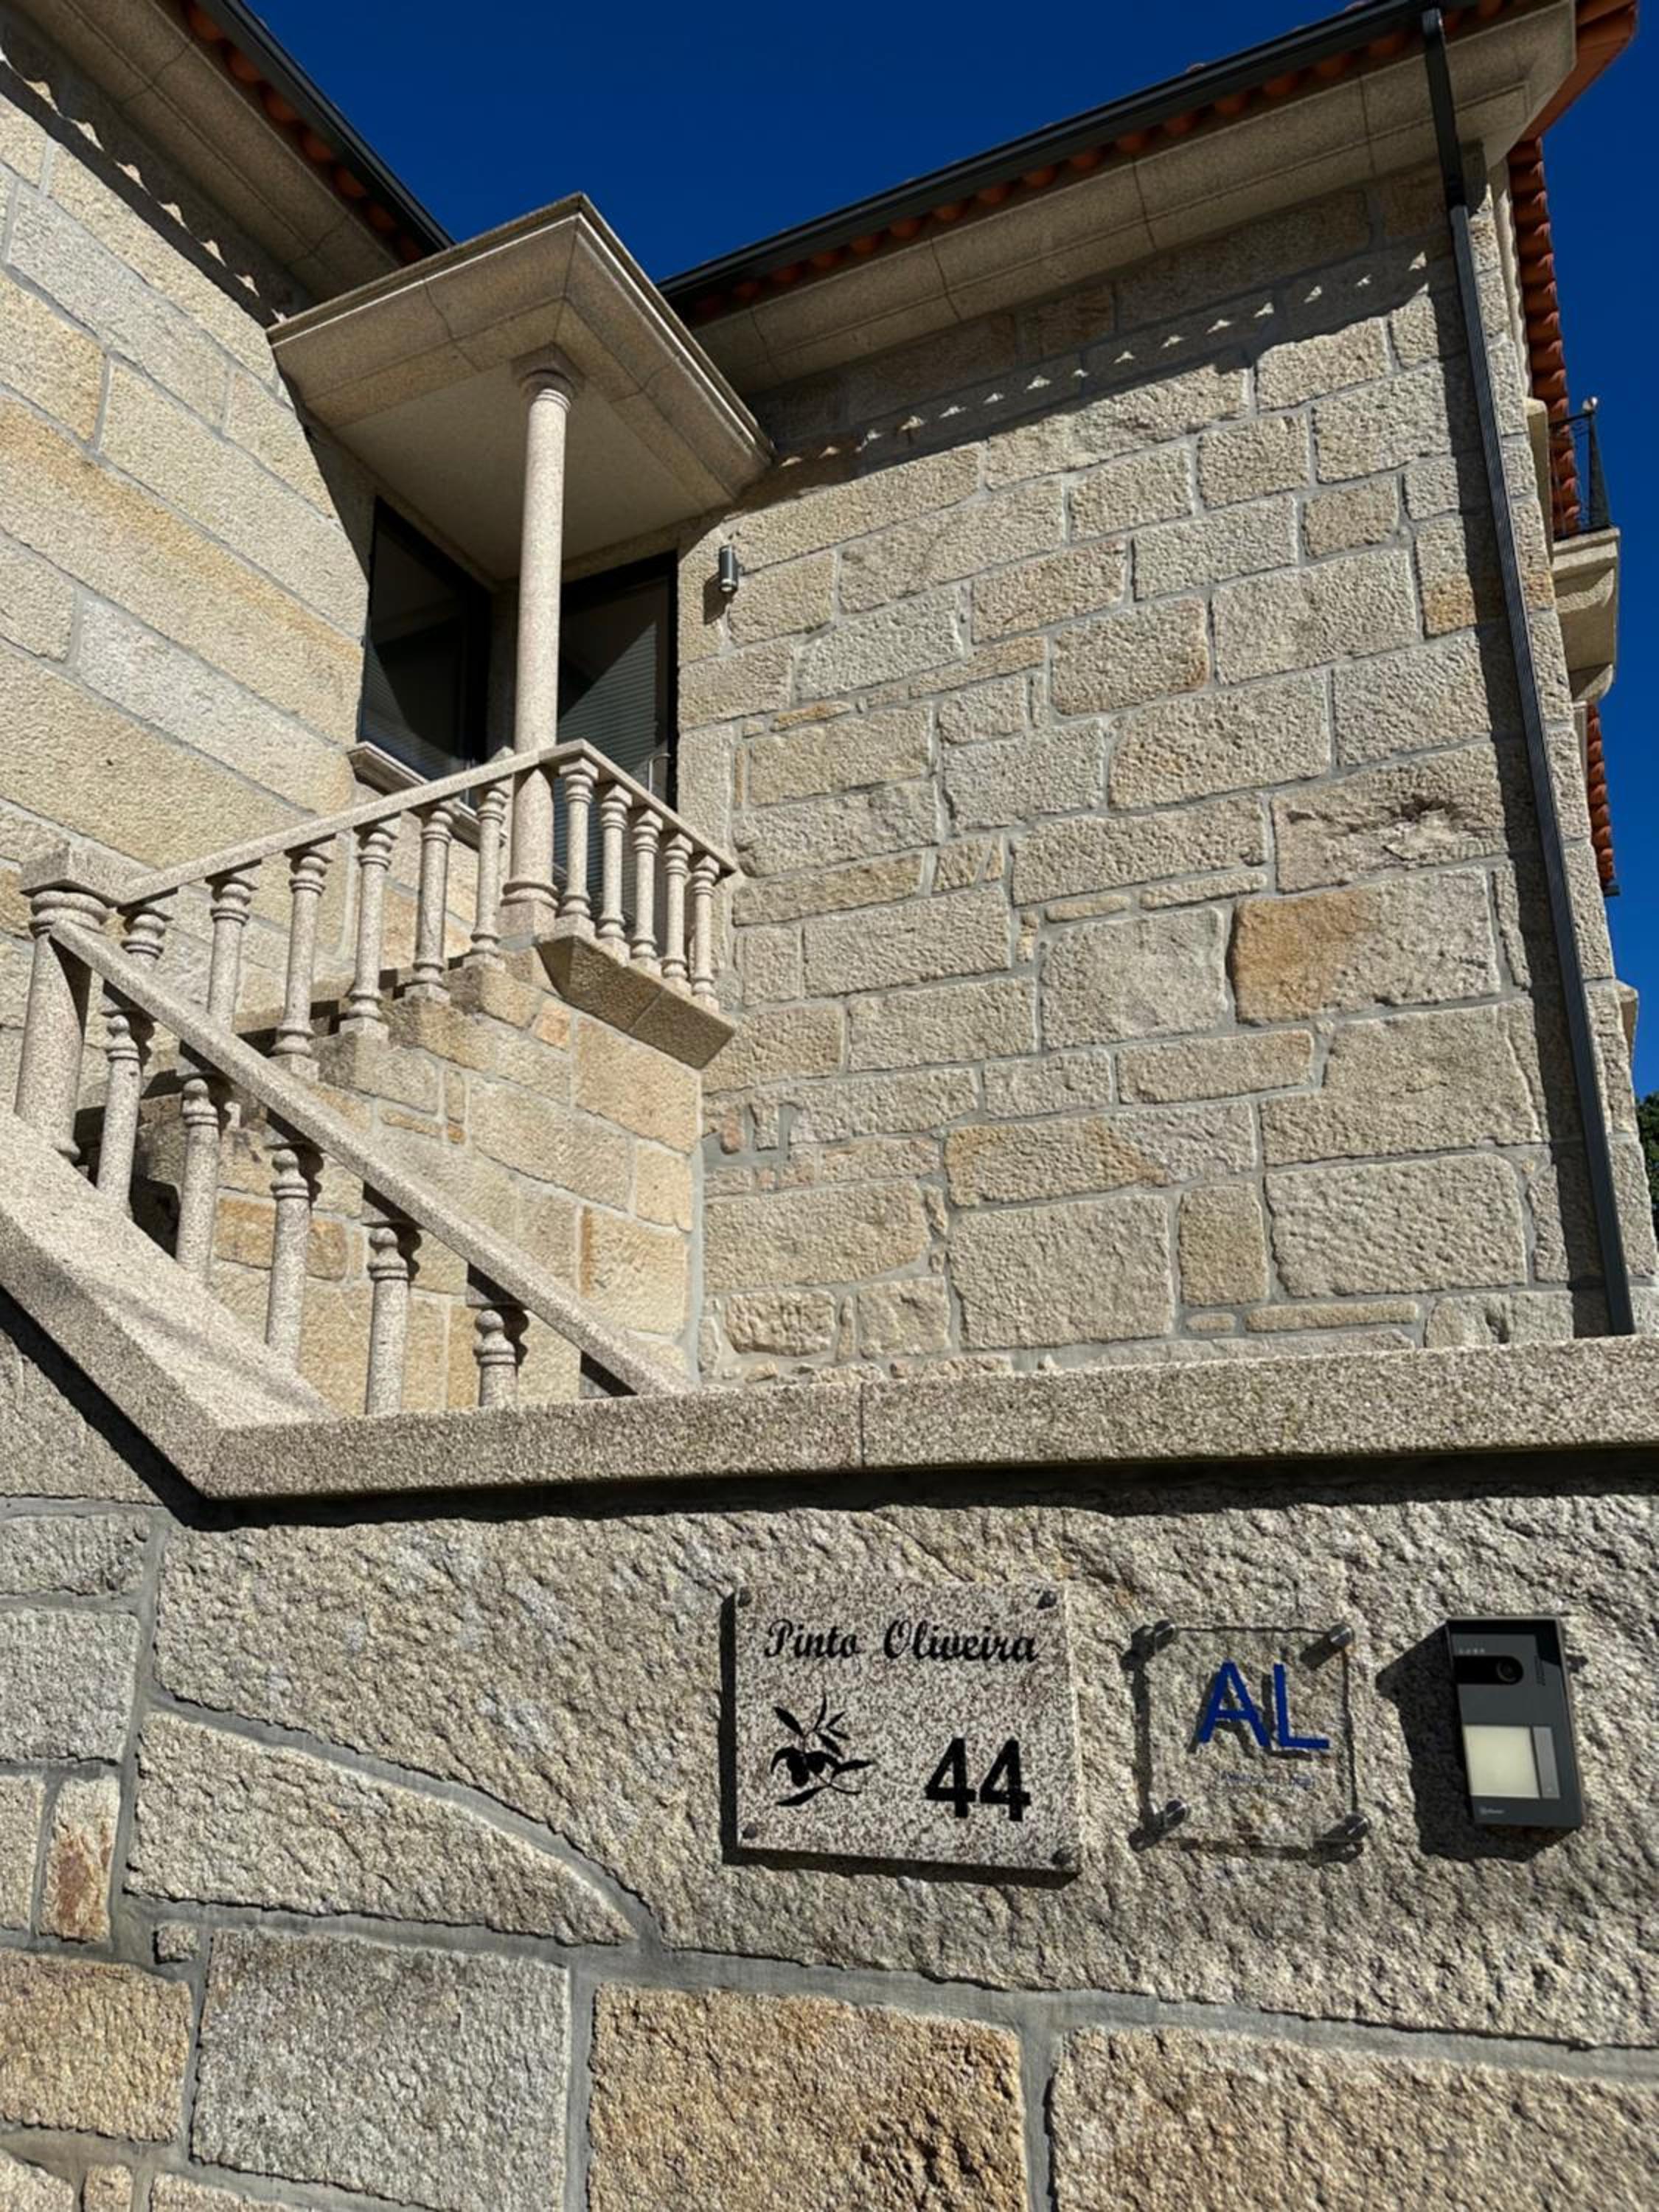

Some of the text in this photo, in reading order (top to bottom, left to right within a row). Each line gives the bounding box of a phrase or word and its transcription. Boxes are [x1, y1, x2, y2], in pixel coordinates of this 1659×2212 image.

[764, 1618, 1038, 1663] Pinto Oliveira
[1197, 1658, 1330, 1750] AL
[924, 1737, 1032, 1822] 44
